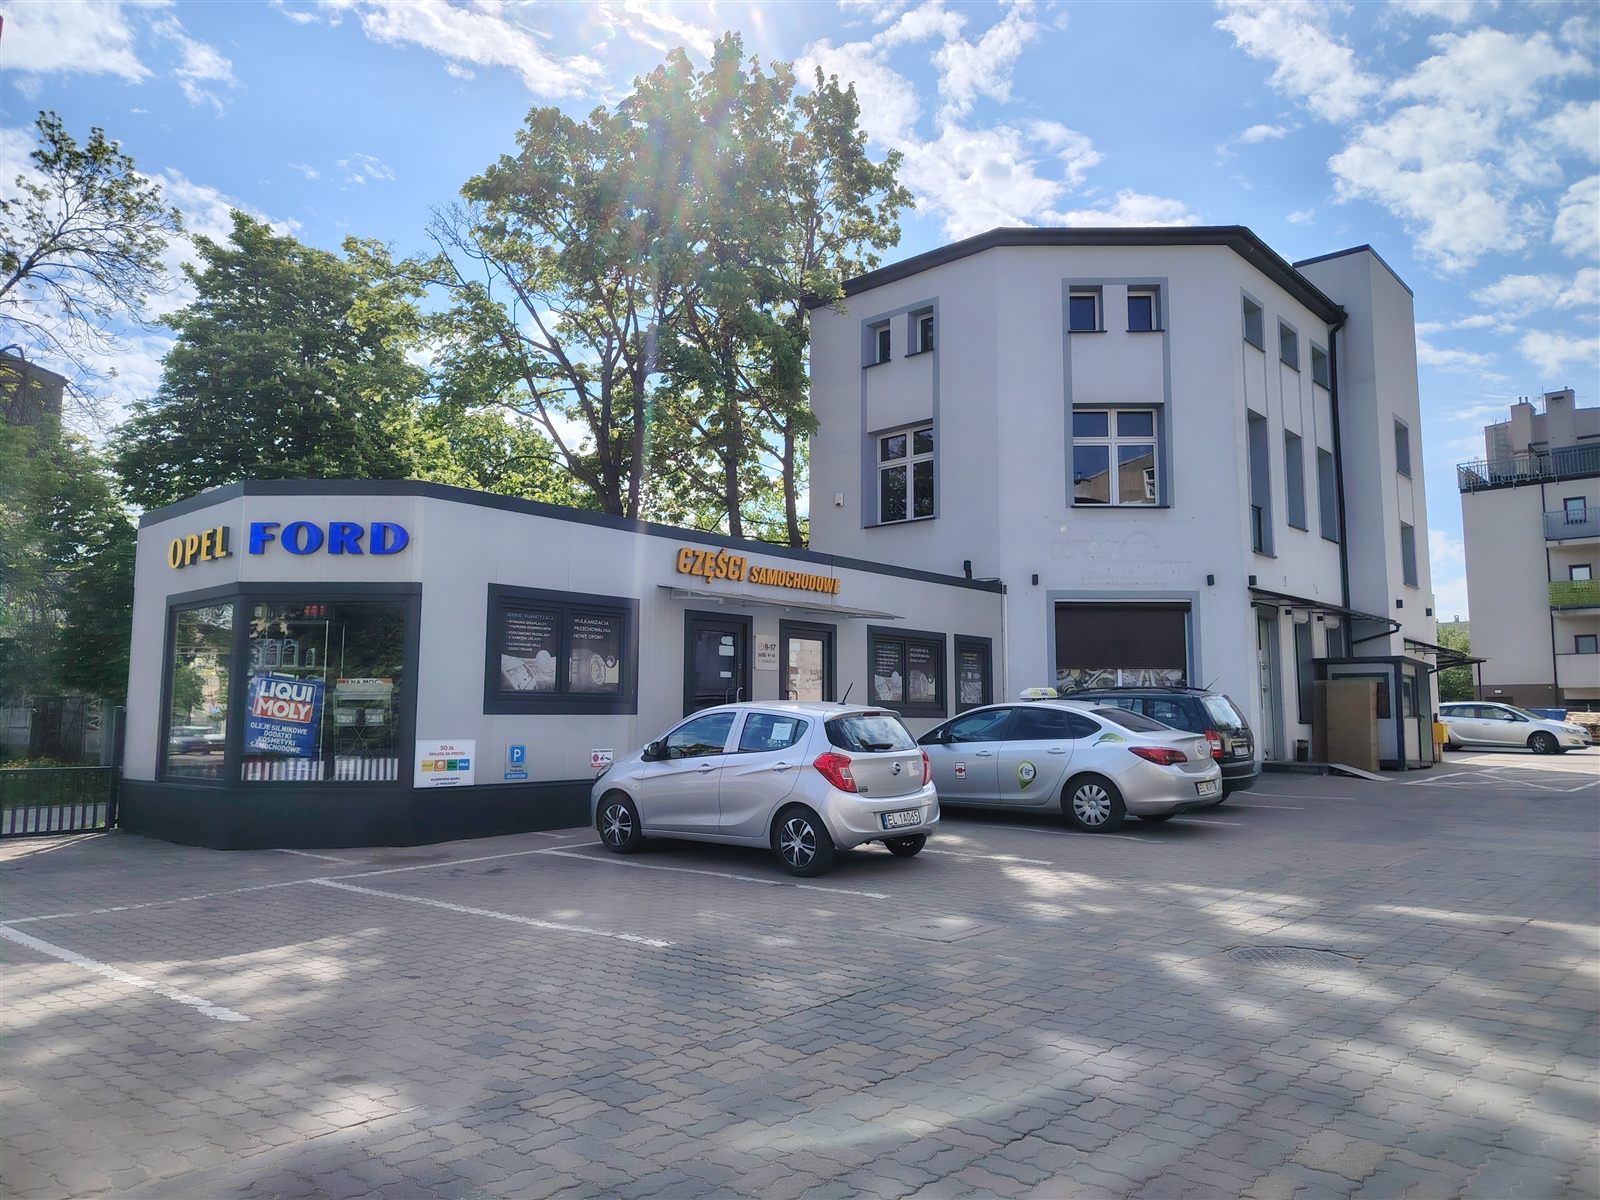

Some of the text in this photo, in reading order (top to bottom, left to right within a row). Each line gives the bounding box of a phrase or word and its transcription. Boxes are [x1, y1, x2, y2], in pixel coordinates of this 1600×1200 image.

[249, 520, 410, 556] FORD
[167, 525, 231, 570] OPEL
[677, 546, 842, 595] CZĘŚCI SAMOCHODOWE
[764, 643, 776, 651] 9-17
[259, 680, 313, 702] LIQUI
[255, 698, 311, 720] MOLY
[250, 721, 308, 735] OLEJE SILNIKOWE
[263, 730, 292, 740] DODATKI
[250, 740, 301, 754] SAMOCHODOWE
[257, 736, 296, 747] KOSMETYKI
[513, 749, 521, 762] P
[887, 814, 898, 826] EL
